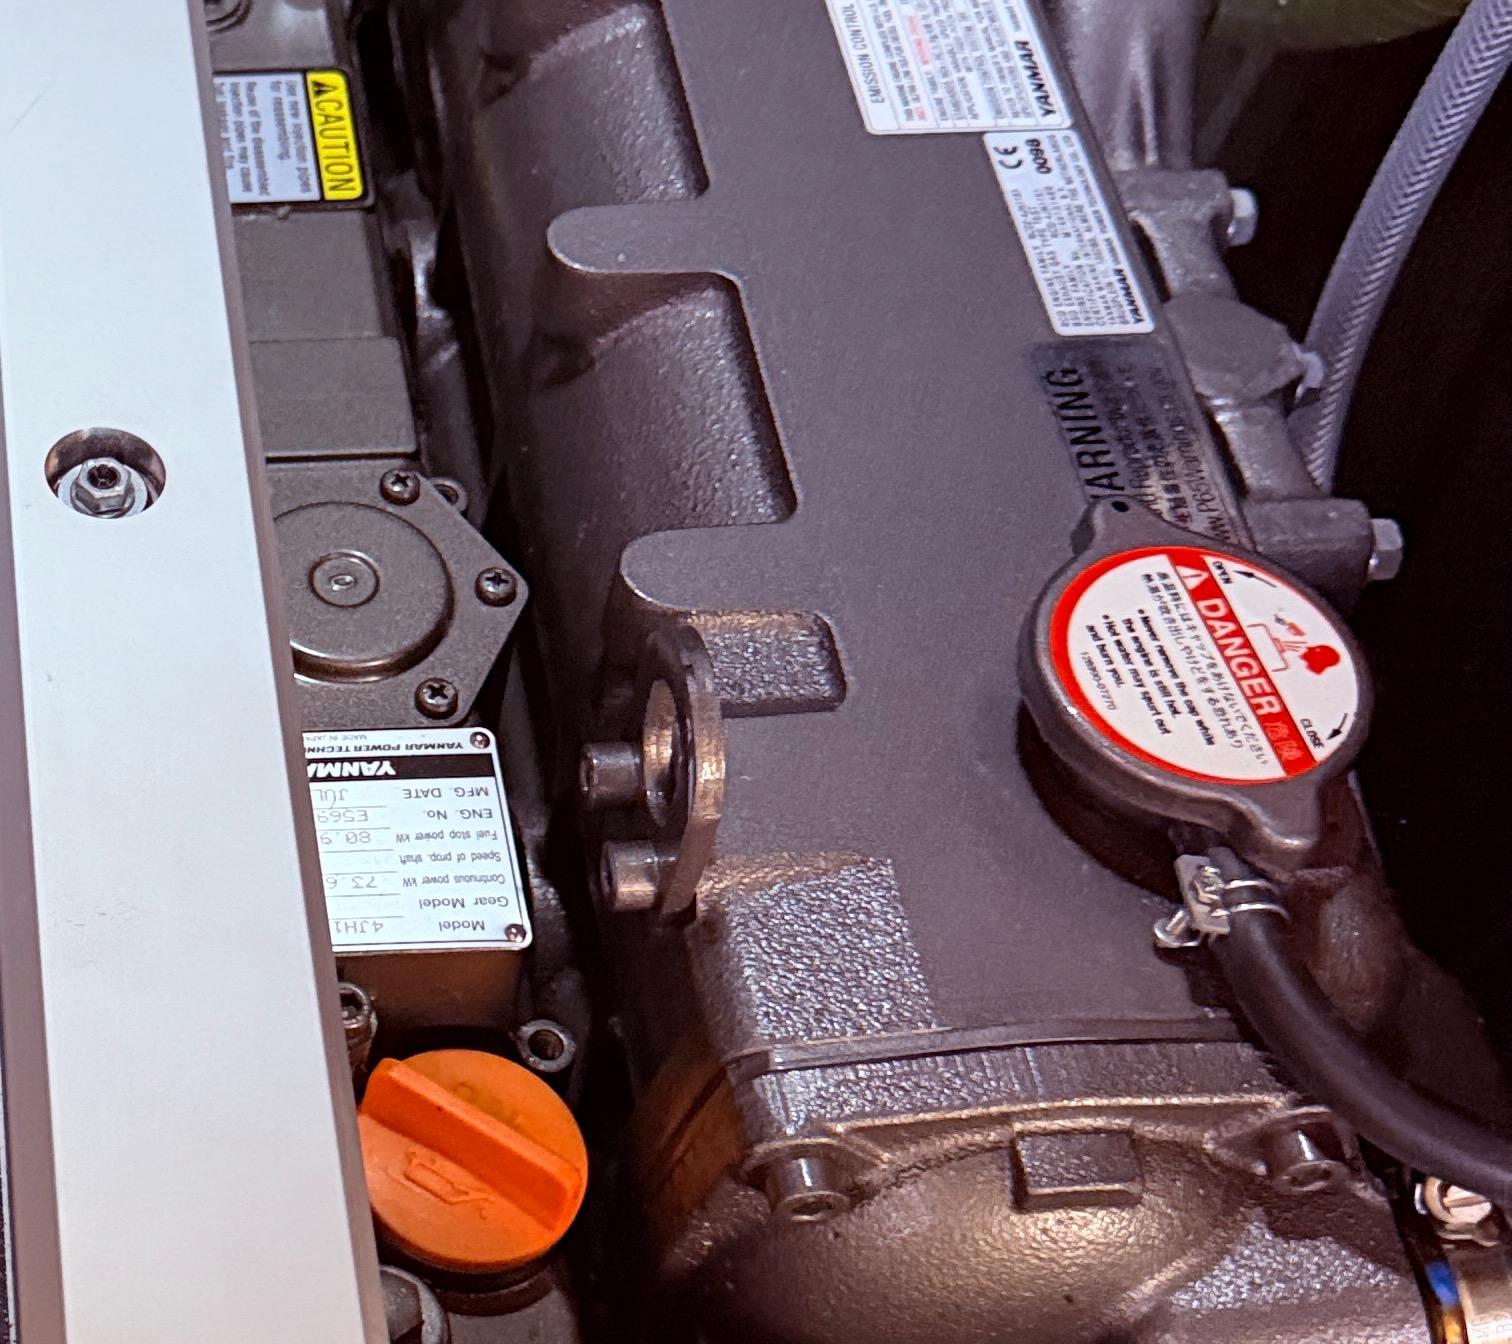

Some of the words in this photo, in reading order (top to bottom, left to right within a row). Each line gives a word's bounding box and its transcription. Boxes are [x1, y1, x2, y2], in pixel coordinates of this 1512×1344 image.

[839, 3, 868, 50] CONTROL
[855, 53, 885, 103] EMISSION
[1012, 40, 1057, 117] YANMAR
[313, 99, 355, 191] CAUTION
[1022, 138, 1053, 174] 0098
[1112, 268, 1144, 323] YANMAR
[1210, 558, 1234, 586] OPEN
[1120, 617, 1138, 634] the
[1137, 614, 1162, 644] Never
[1083, 622, 1102, 643] and
[1094, 642, 1115, 666] burn
[1127, 634, 1155, 668] engine
[1192, 592, 1285, 719] DANGER
[1152, 643, 1181, 680] remove
[1102, 619, 1120, 638] Hot
[1112, 638, 1135, 667] water
[1125, 667, 1147, 690] may
[1137, 689, 1162, 717] spurt
[1153, 717, 1172, 736] out
[1147, 667, 1162, 679] is
[1153, 678, 1173, 699] still
[1172, 680, 1190, 698] the
[1180, 698, 1200, 719] cap
[1193, 718, 1217, 746] while
[1297, 716, 1326, 751] CLOSE
[303, 744, 350, 753] TECHN
[352, 743, 401, 751] POWER
[403, 741, 463, 750] YANMAR
[401, 787, 442, 799] DATE
[421, 809, 447, 819] No.
[393, 832, 410, 842] kW
[413, 830, 444, 840] power
[448, 829, 471, 839] stop
[475, 829, 497, 839] Fuel
[397, 854, 423, 864] shaft
[426, 851, 452, 861] prop.
[454, 852, 466, 862] of
[469, 851, 501, 862] Speed
[401, 876, 417, 887] kW
[420, 873, 449, 885] power
[452, 873, 506, 885] Continuous
[417, 897, 466, 909] Model
[471, 895, 509, 907] Gear
[437, 919, 485, 932] Model
